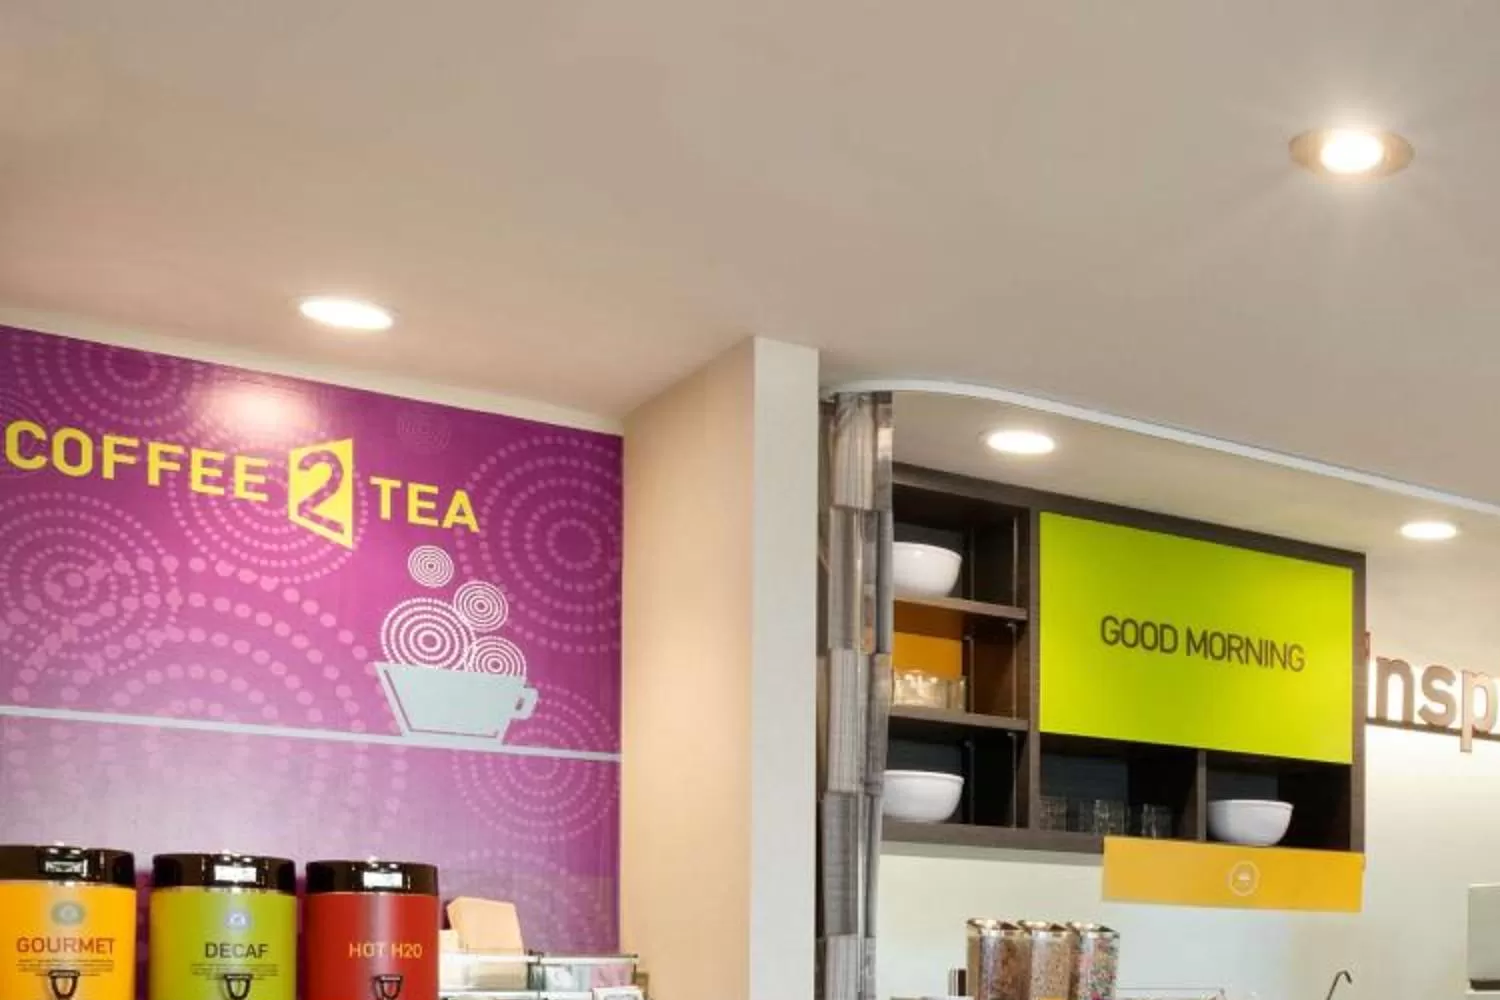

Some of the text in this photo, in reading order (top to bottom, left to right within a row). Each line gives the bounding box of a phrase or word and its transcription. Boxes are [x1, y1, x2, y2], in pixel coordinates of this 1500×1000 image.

[4, 419, 270, 503] COFFEE
[371, 475, 481, 533] TEA
[1100, 614, 1306, 673] GOOD MORNING
[15, 937, 115, 955] GOURMET
[204, 943, 270, 959] DECAF
[348, 942, 385, 959] HOT
